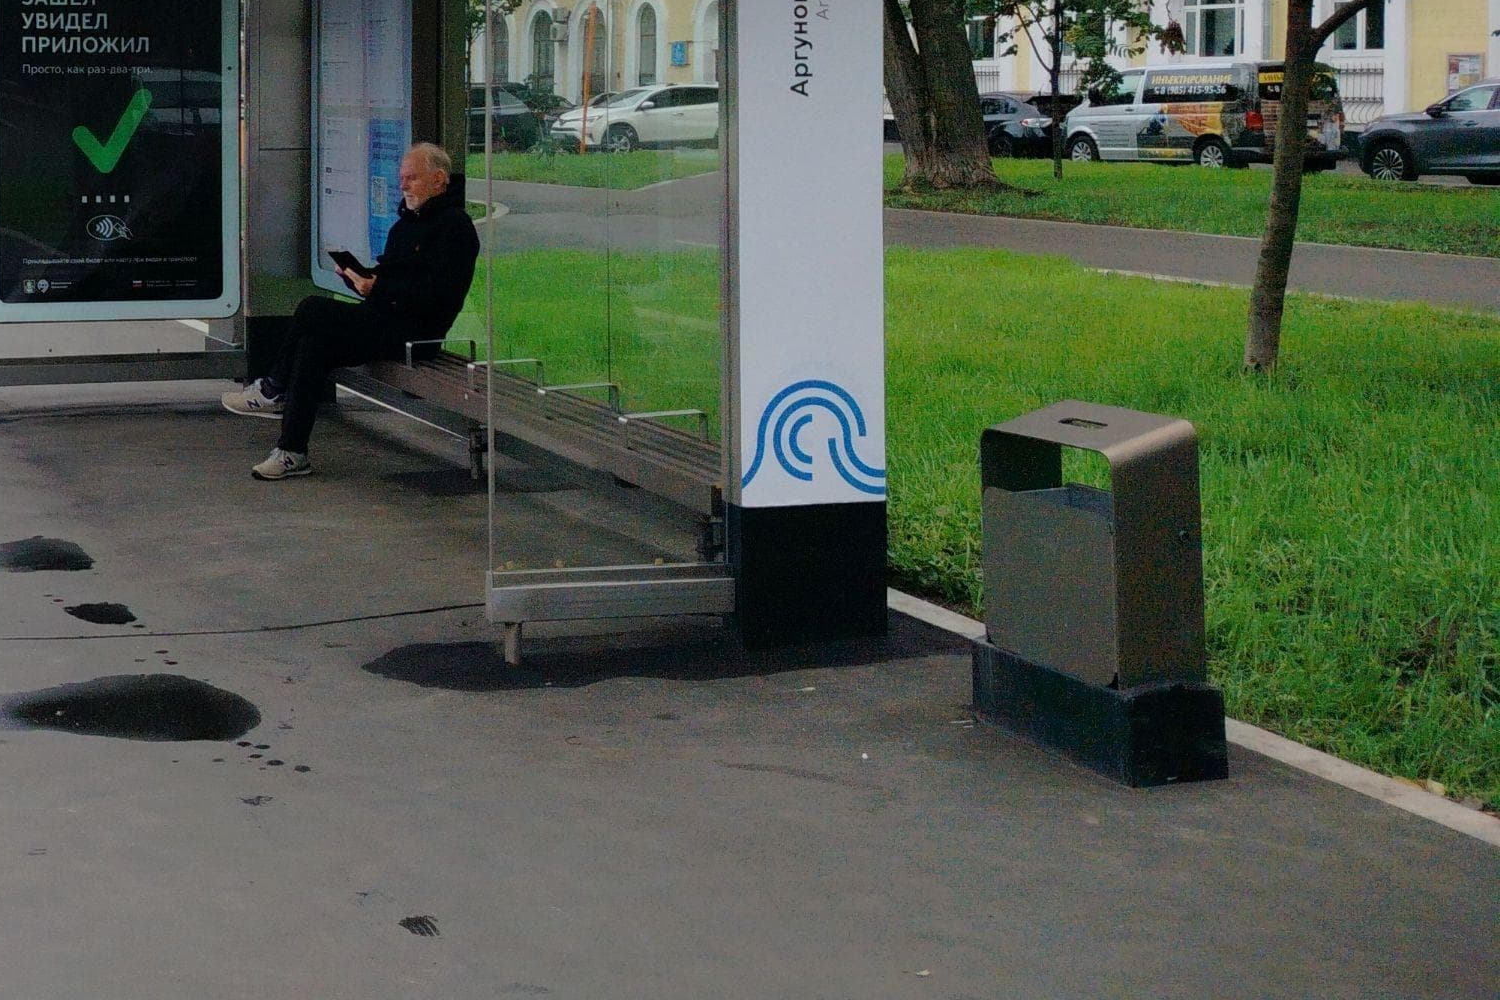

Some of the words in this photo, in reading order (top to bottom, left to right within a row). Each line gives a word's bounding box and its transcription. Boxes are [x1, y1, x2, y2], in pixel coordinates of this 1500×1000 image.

[21, 13, 108, 32] УВИДЕЛ
[21, 36, 150, 54] ПРИЛОЖИЛ
[22, 63, 65, 75] Просто,
[67, 66, 85, 74] как
[1160, 87, 1166, 95] 8
